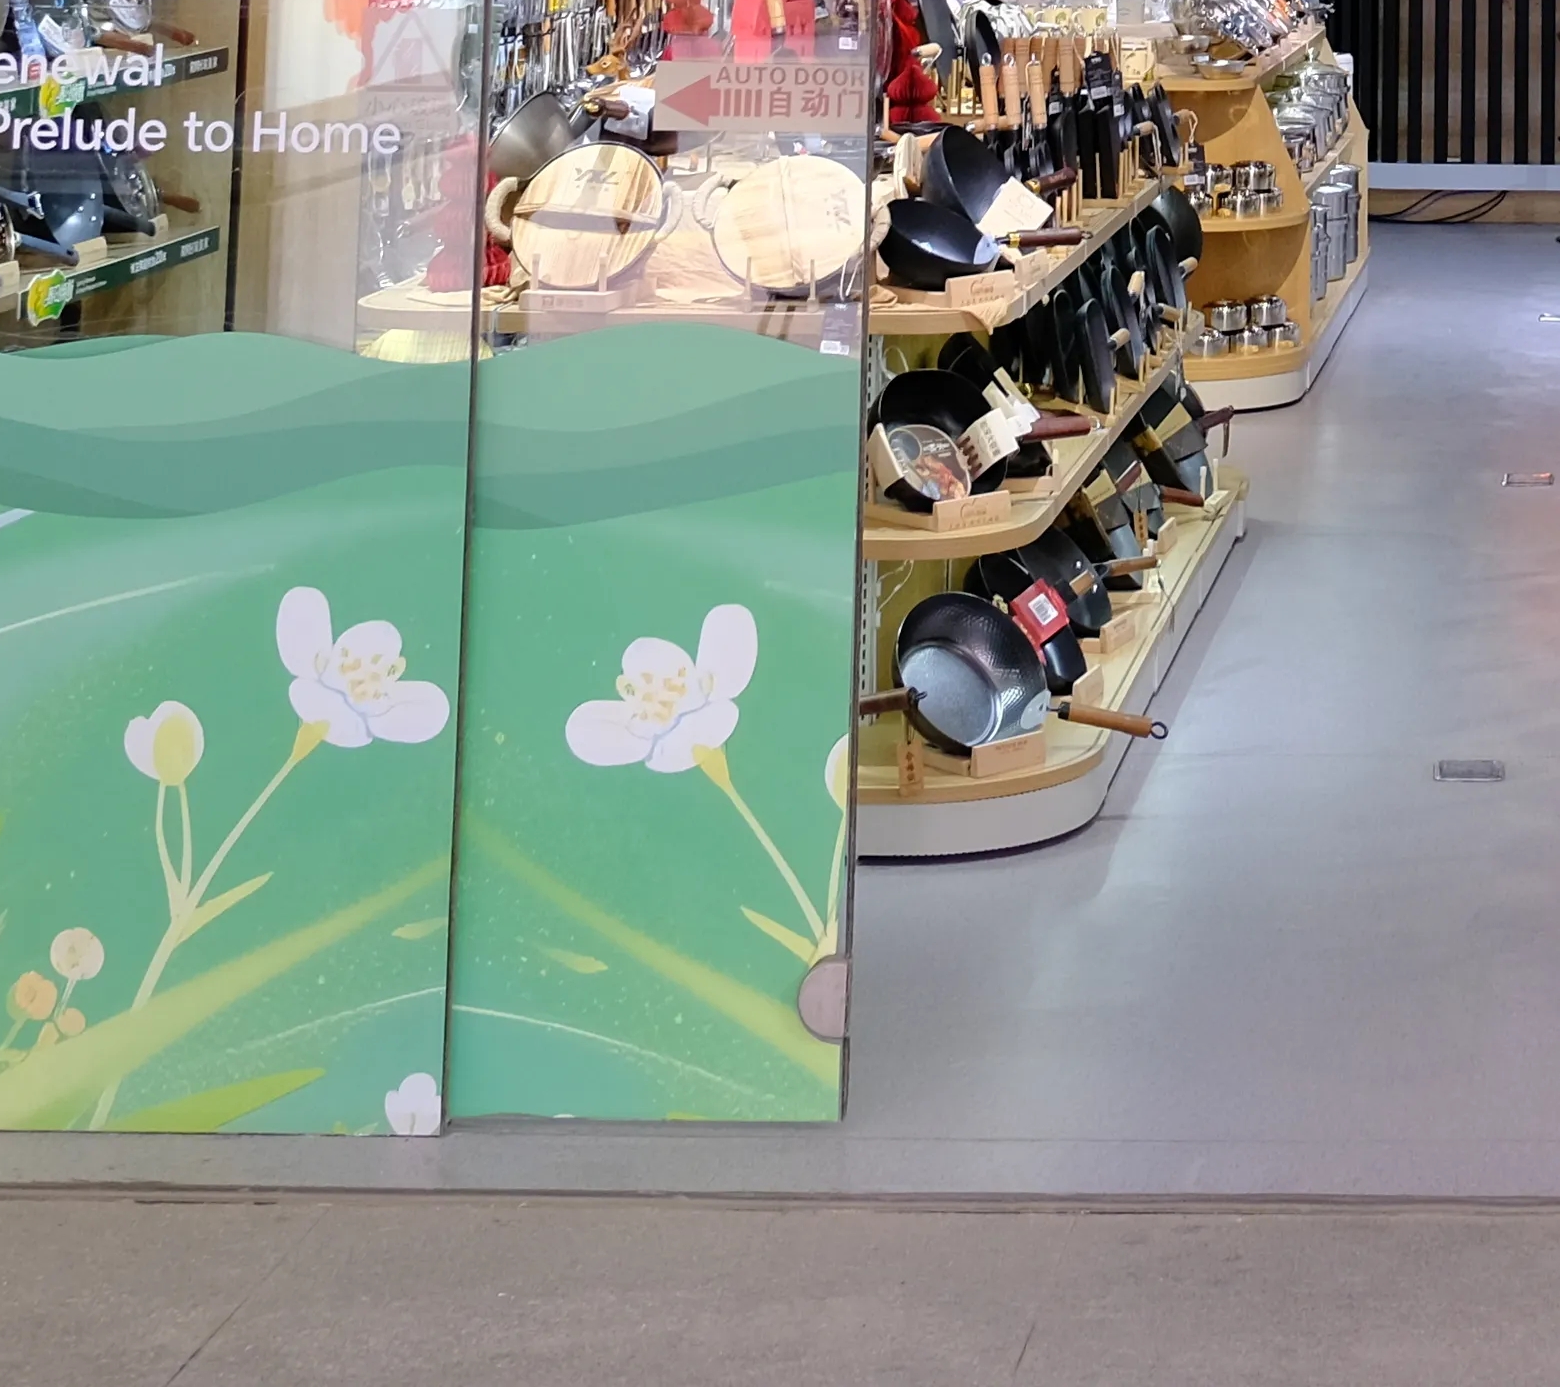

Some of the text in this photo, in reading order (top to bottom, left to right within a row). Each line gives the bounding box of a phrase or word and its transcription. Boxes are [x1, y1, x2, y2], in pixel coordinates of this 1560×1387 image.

[716, 65, 866, 88] AUTO DOOR
[768, 88, 866, 119] 自动门
[183, 113, 233, 154] to
[252, 112, 402, 157] Home
